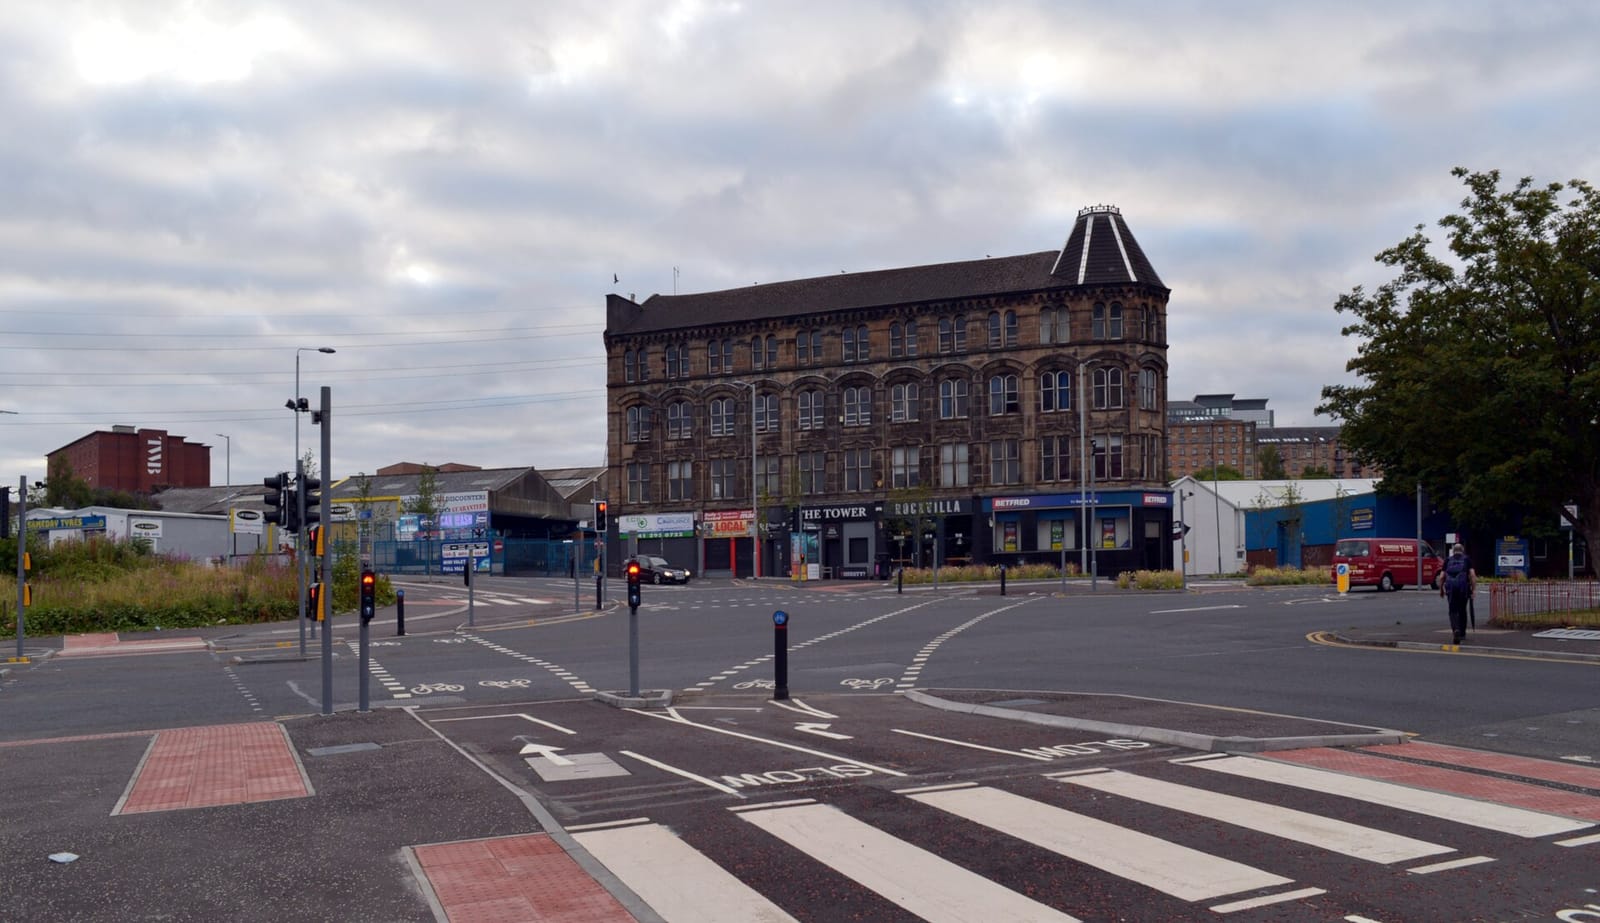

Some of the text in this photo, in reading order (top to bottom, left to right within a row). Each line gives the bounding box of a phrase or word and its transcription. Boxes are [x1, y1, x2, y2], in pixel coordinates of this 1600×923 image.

[445, 494, 486, 502] DISCOUNTERS
[994, 498, 1030, 507] BETFRED
[1144, 495, 1167, 503] BETFRED
[451, 503, 487, 513] GUARANTEED
[801, 507, 867, 519] HE TOWER
[895, 500, 960, 515] ROCKVILLA
[61, 517, 82, 528] TYRES
[715, 521, 745, 532] LOCAL
[1021, 739, 1150, 757] SLOW
[721, 764, 873, 788] SLOW
